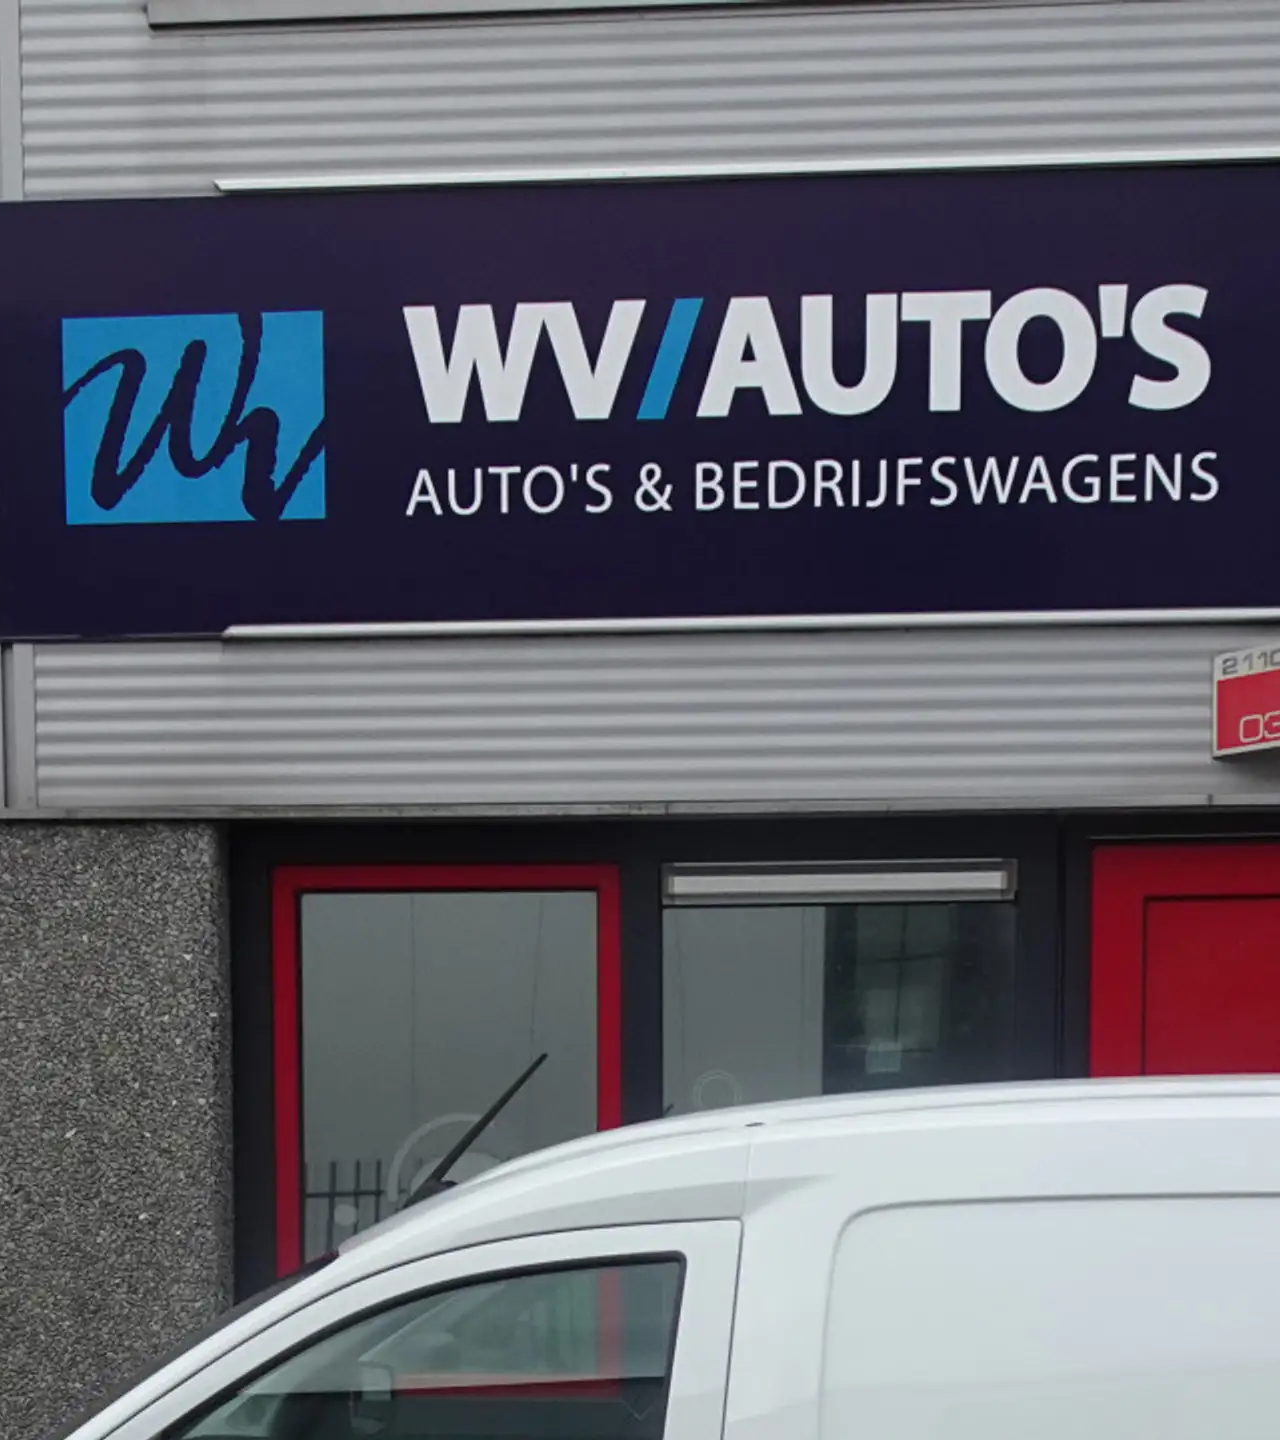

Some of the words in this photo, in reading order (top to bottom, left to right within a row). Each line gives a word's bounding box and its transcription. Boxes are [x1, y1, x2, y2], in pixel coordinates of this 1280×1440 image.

[405, 463, 613, 516] AUTO'S
[634, 462, 673, 512] &
[695, 451, 1219, 511] BEDRIJFSWAGENS
